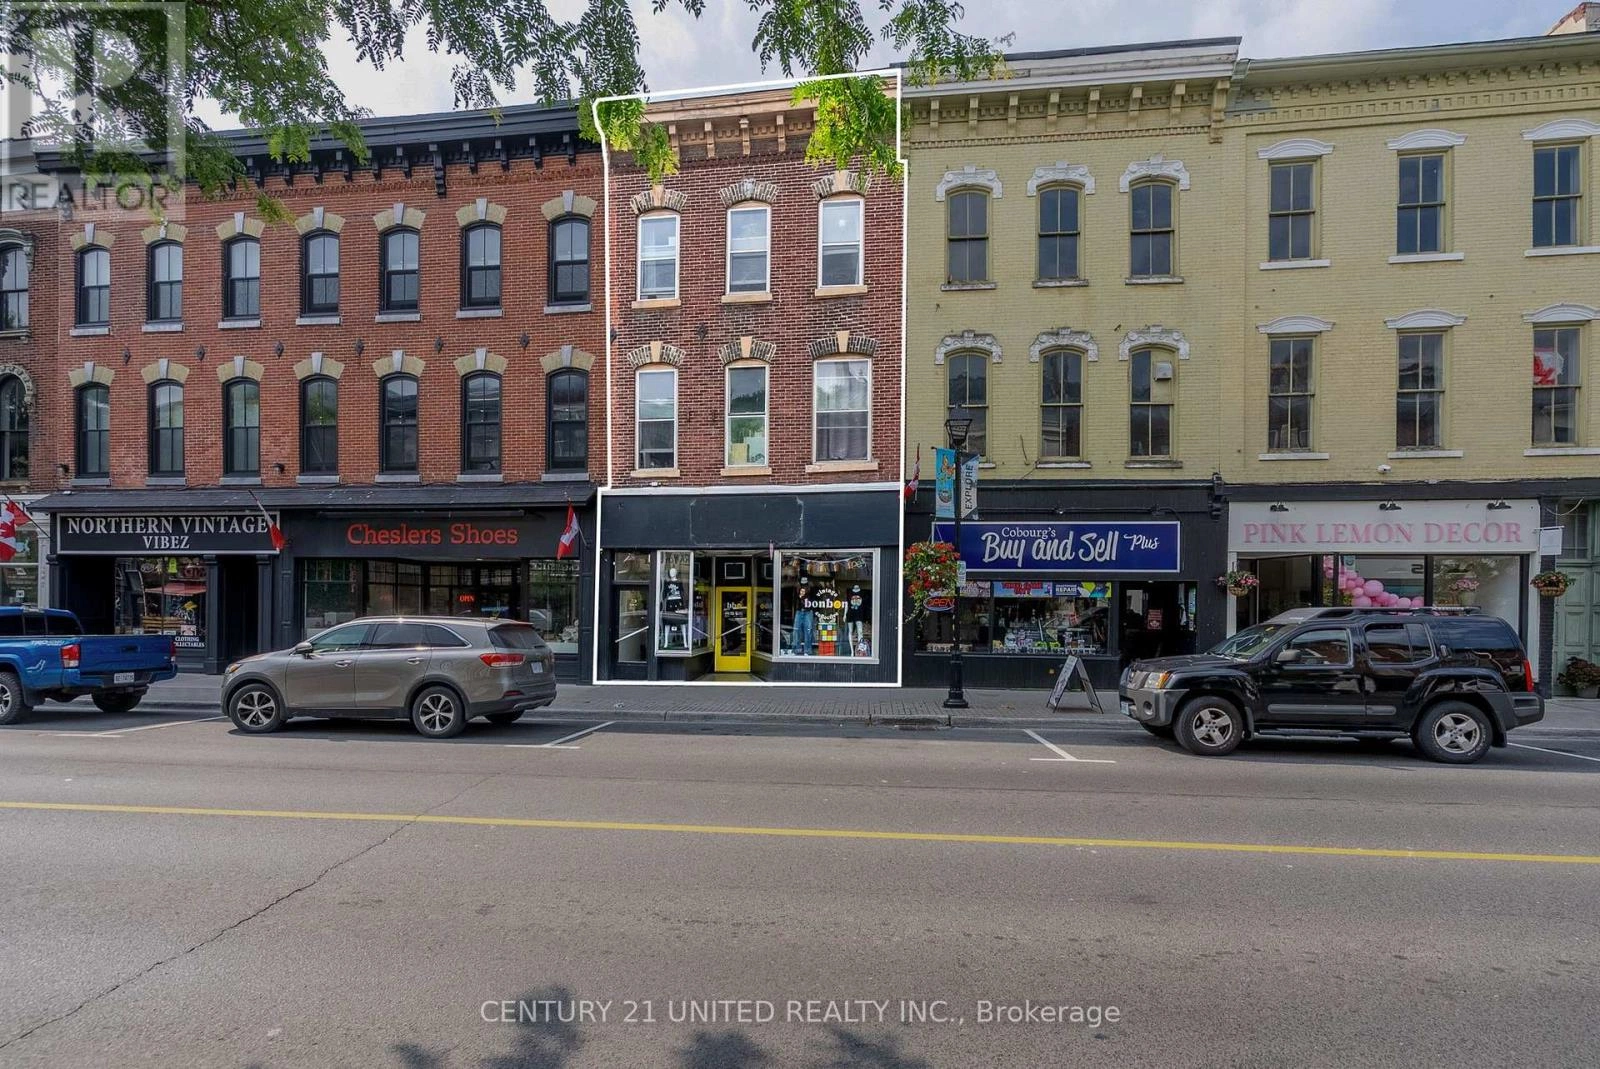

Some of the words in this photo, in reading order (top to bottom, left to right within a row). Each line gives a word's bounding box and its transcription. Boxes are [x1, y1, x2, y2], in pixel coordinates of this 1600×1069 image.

[965, 464, 974, 510] EXPLORE
[67, 517, 173, 534] NORTHERN
[180, 516, 268, 534] VINTAGE
[347, 524, 442, 544] Cheslers
[450, 524, 518, 544] Shoes
[1001, 527, 1056, 539] Cobourg's
[1243, 523, 1307, 543] PINK
[1316, 523, 1413, 543] LEMON
[1424, 522, 1522, 543] DECOR
[143, 536, 190, 549] VIBEZ
[981, 531, 1026, 568] Buy
[1031, 531, 1075, 561] and
[1078, 530, 1119, 562] Sell
[1124, 533, 1160, 552] Plus
[804, 598, 849, 609] bonbon
